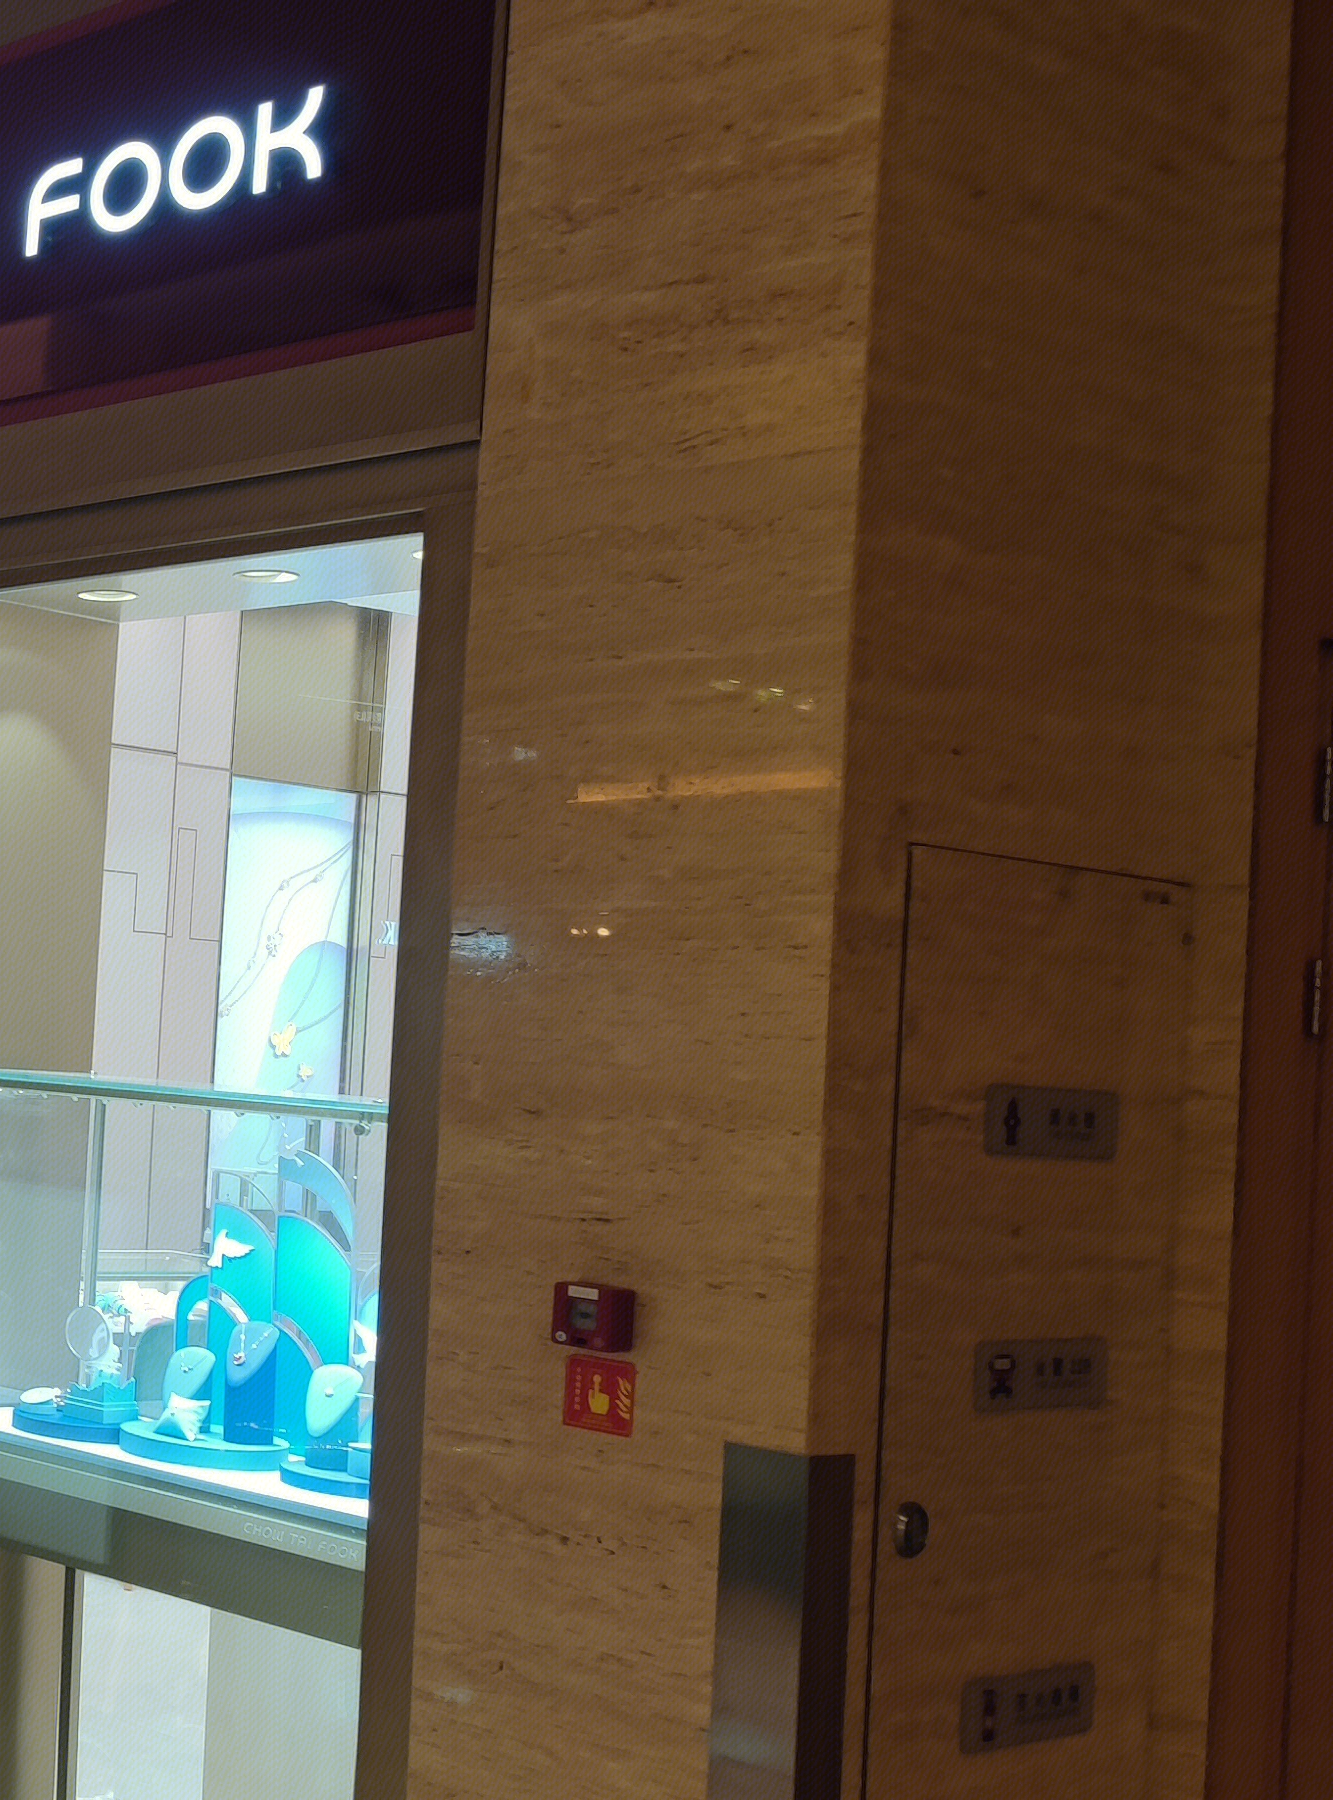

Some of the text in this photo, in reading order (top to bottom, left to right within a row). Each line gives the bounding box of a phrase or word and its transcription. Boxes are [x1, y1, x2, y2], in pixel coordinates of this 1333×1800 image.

[23, 84, 327, 259] FOOK
[243, 1522, 359, 1562] CHOW TAI FOOK
